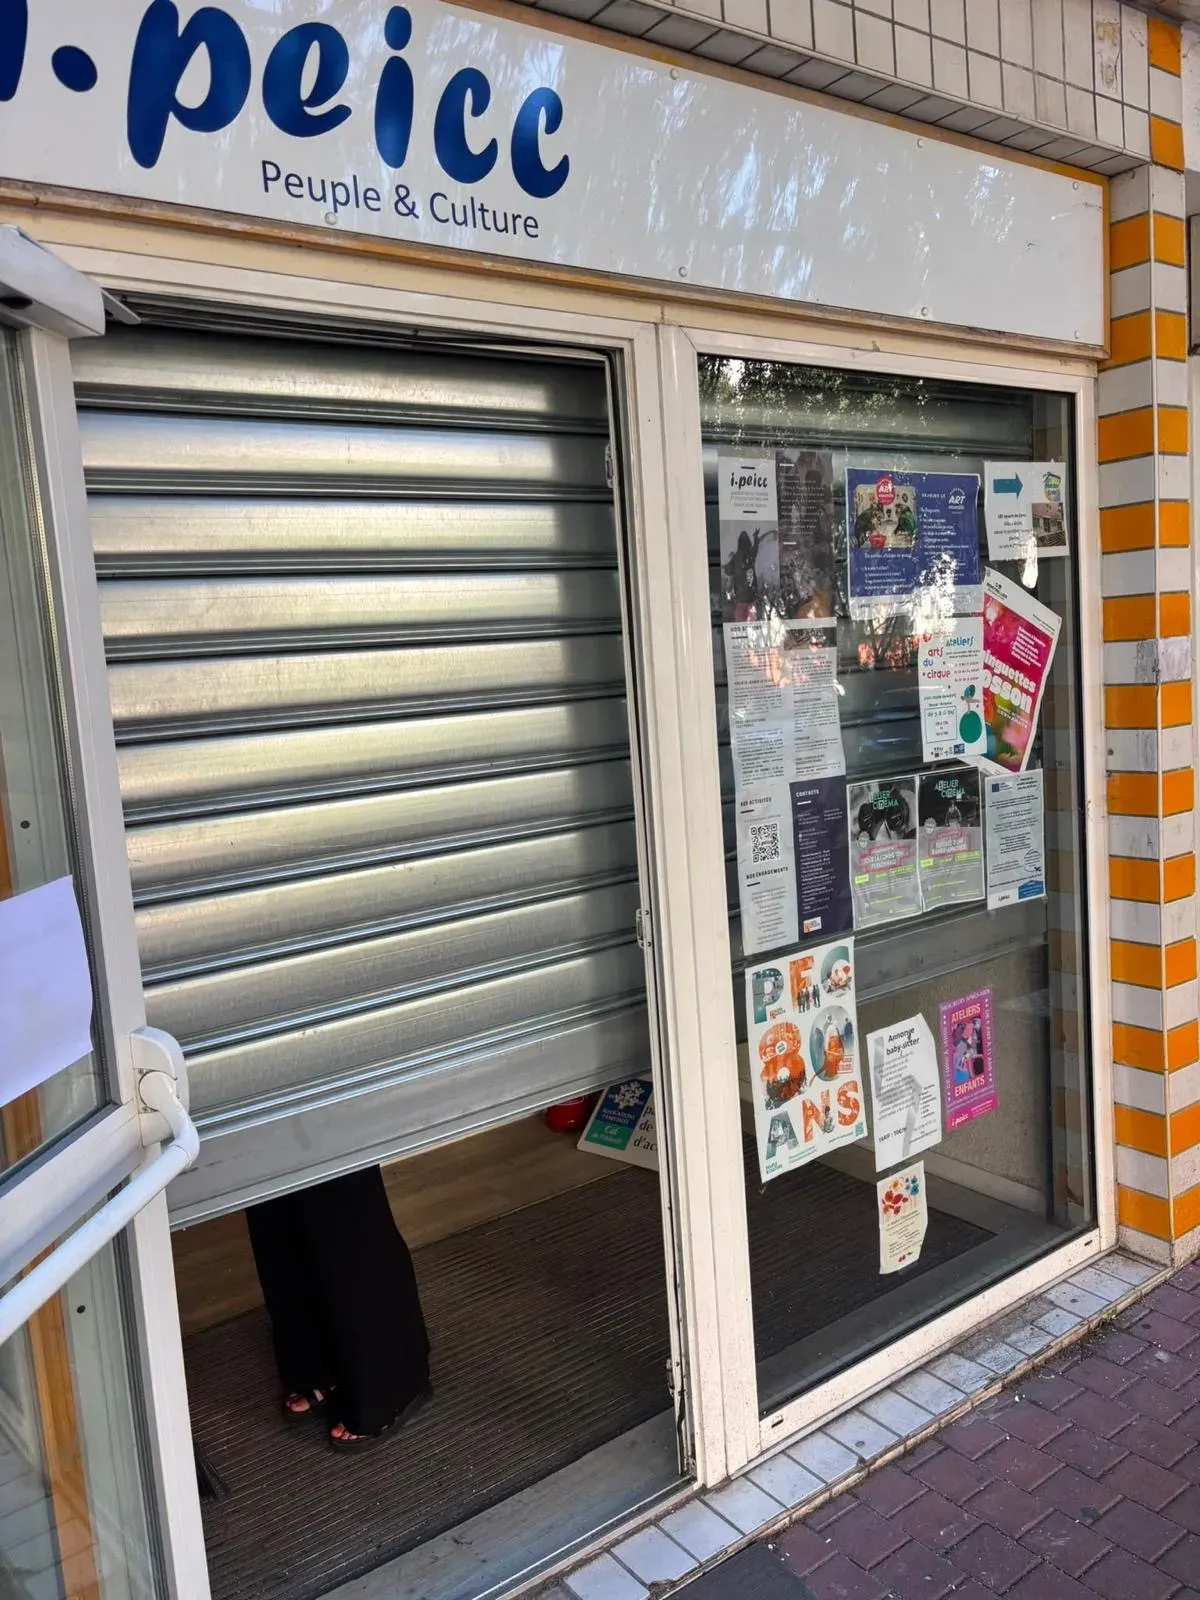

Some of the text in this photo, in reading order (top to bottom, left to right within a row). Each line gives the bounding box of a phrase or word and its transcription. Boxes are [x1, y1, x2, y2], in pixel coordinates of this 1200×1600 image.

[261, 160, 540, 238] Peuple & Culture
[730, 472, 768, 490] i.peicc
[922, 657, 934, 667] du
[984, 649, 1036, 693] inguettes
[982, 668, 1033, 714] osson
[951, 1003, 981, 1023] ATELIERS
[758, 1004, 856, 1112] 80
[954, 1076, 985, 1097] ENFANTS
[639, 1120, 653, 1132] de
[765, 1079, 861, 1161] ANS
[633, 1136, 658, 1152] d'ac
